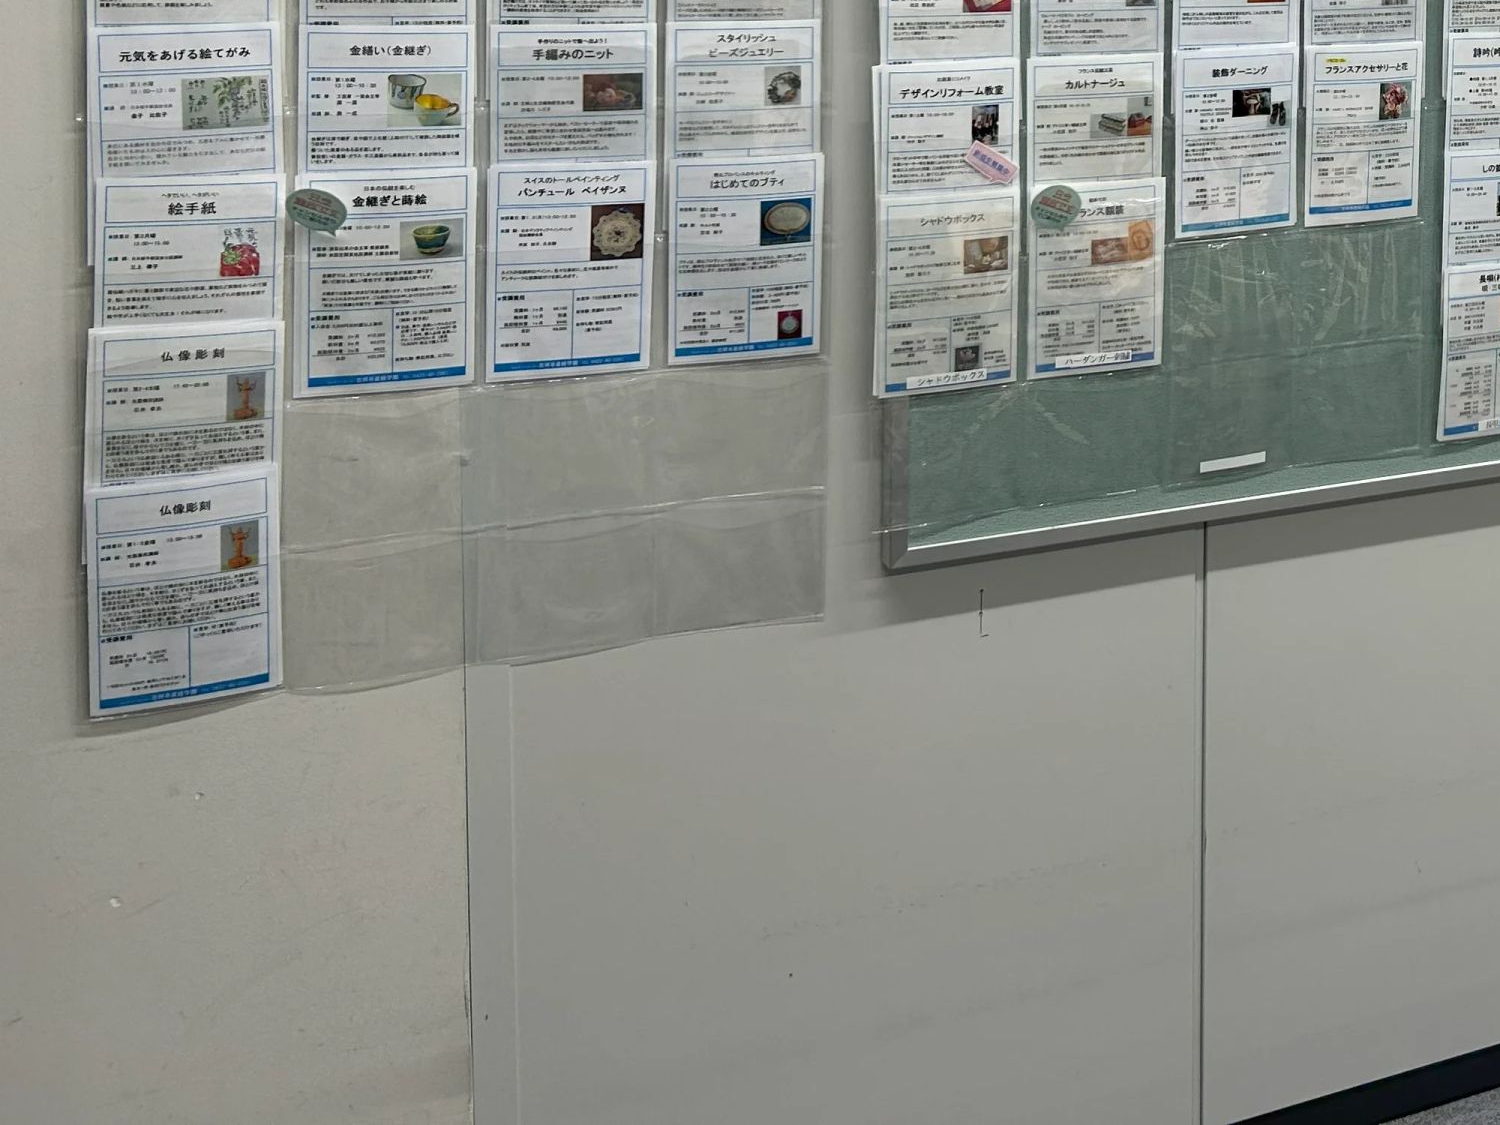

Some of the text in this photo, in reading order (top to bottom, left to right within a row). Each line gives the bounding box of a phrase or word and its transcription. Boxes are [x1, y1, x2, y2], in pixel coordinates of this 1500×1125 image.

[717, 34, 776, 43] スタイリッシュ
[119, 47, 251, 63] 元気をあげる絵てがみ
[349, 45, 431, 56] 金繕い（金継ぎ）
[532, 49, 614, 61] 手編みのニット
[709, 48, 784, 57] ビーズジュエリー
[1212, 66, 1268, 78] 装飾ダーニング
[1325, 62, 1408, 74] フランスアクセサリーと花
[1065, 78, 1126, 89] カルトナージュ
[900, 85, 1005, 99] デザインリフォーム教室
[352, 194, 428, 207] 金継ぎと蒔絵
[168, 201, 217, 216] 絵手紙
[920, 214, 985, 226] シャドウボックス
[161, 347, 226, 362] 仏像彫刻
[917, 371, 985, 386] シャドウボックス
[159, 500, 211, 516] 仏像彫刻
